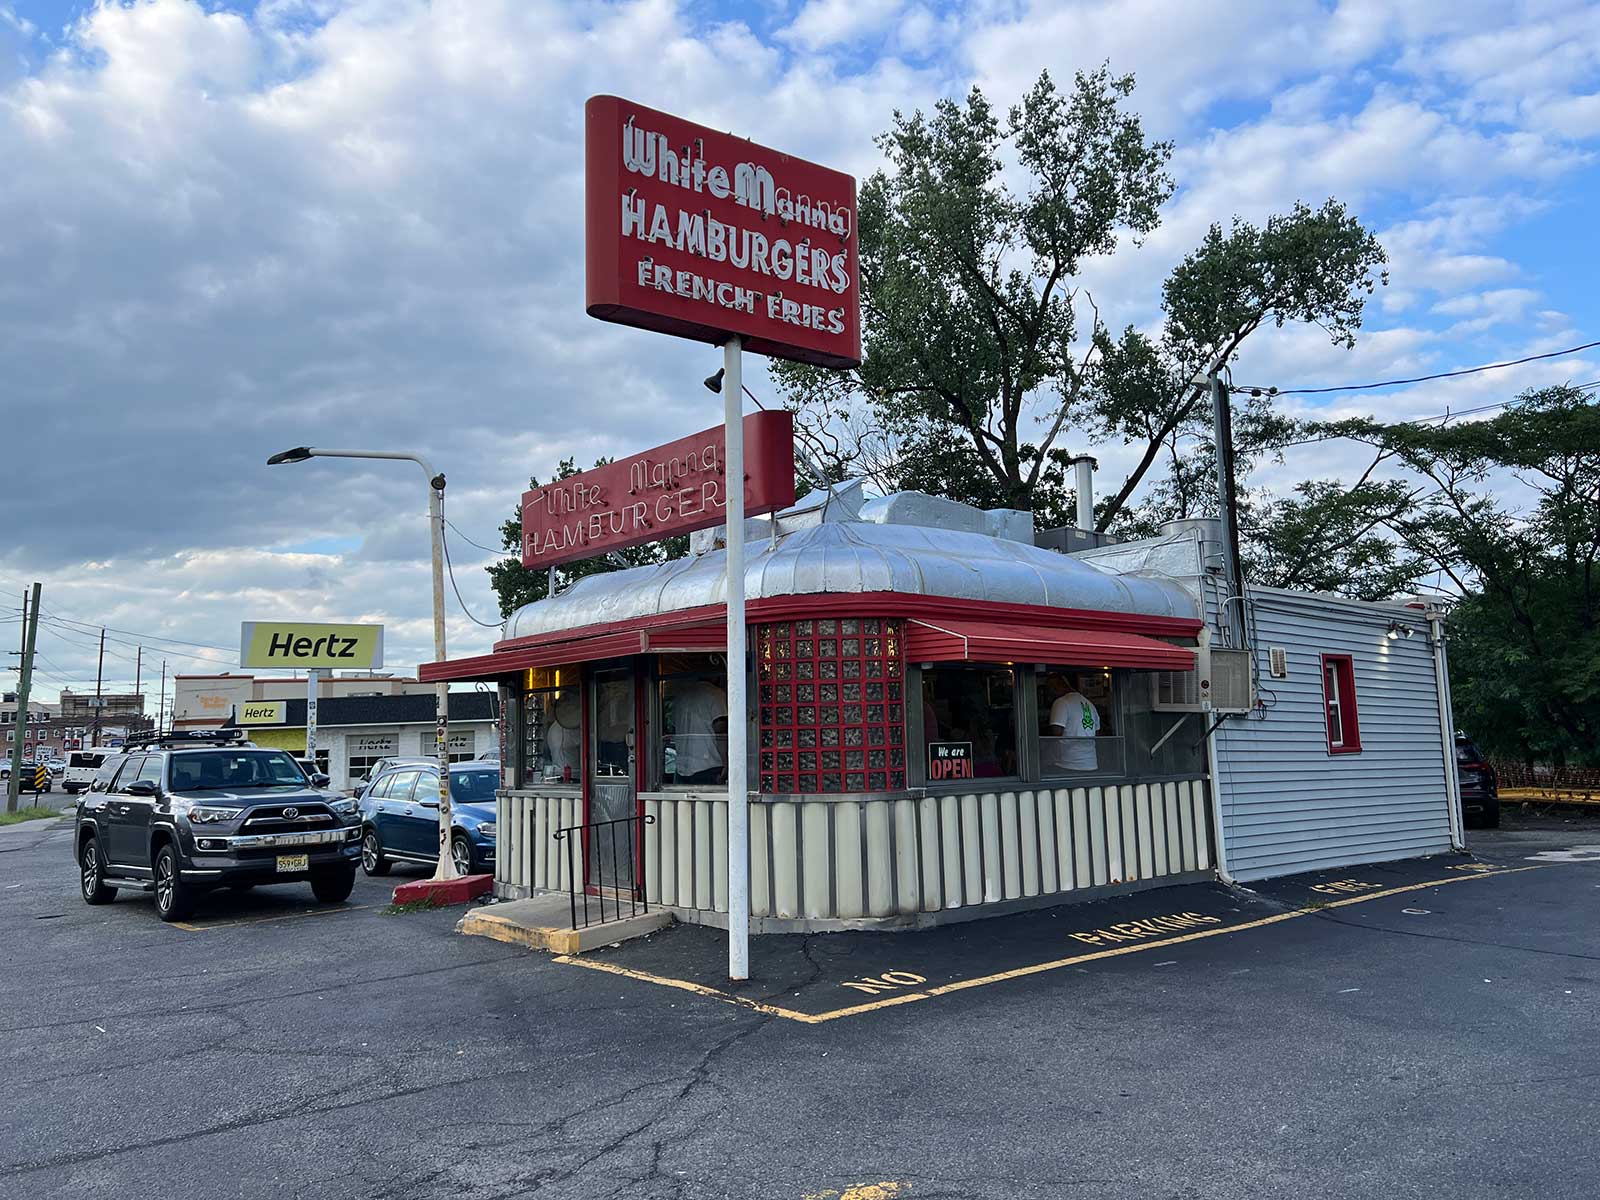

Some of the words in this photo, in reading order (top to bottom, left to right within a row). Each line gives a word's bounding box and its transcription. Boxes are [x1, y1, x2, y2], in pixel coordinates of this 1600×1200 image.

[622, 117, 731, 200] White
[734, 162, 851, 238] Manna
[621, 190, 851, 295] HAMBURGERS
[637, 258, 757, 314] FRENCH
[766, 293, 845, 335] FRIES
[629, 445, 718, 493] Manna
[525, 480, 728, 557] HAMBURGER
[268, 633, 358, 657] Hertz
[244, 708, 275, 718] Hertz
[931, 759, 972, 779] OPEN
[938, 746, 949, 757] We
[951, 748, 965, 756] are
[841, 971, 927, 994] NO
[1067, 907, 1222, 946] PARKING
